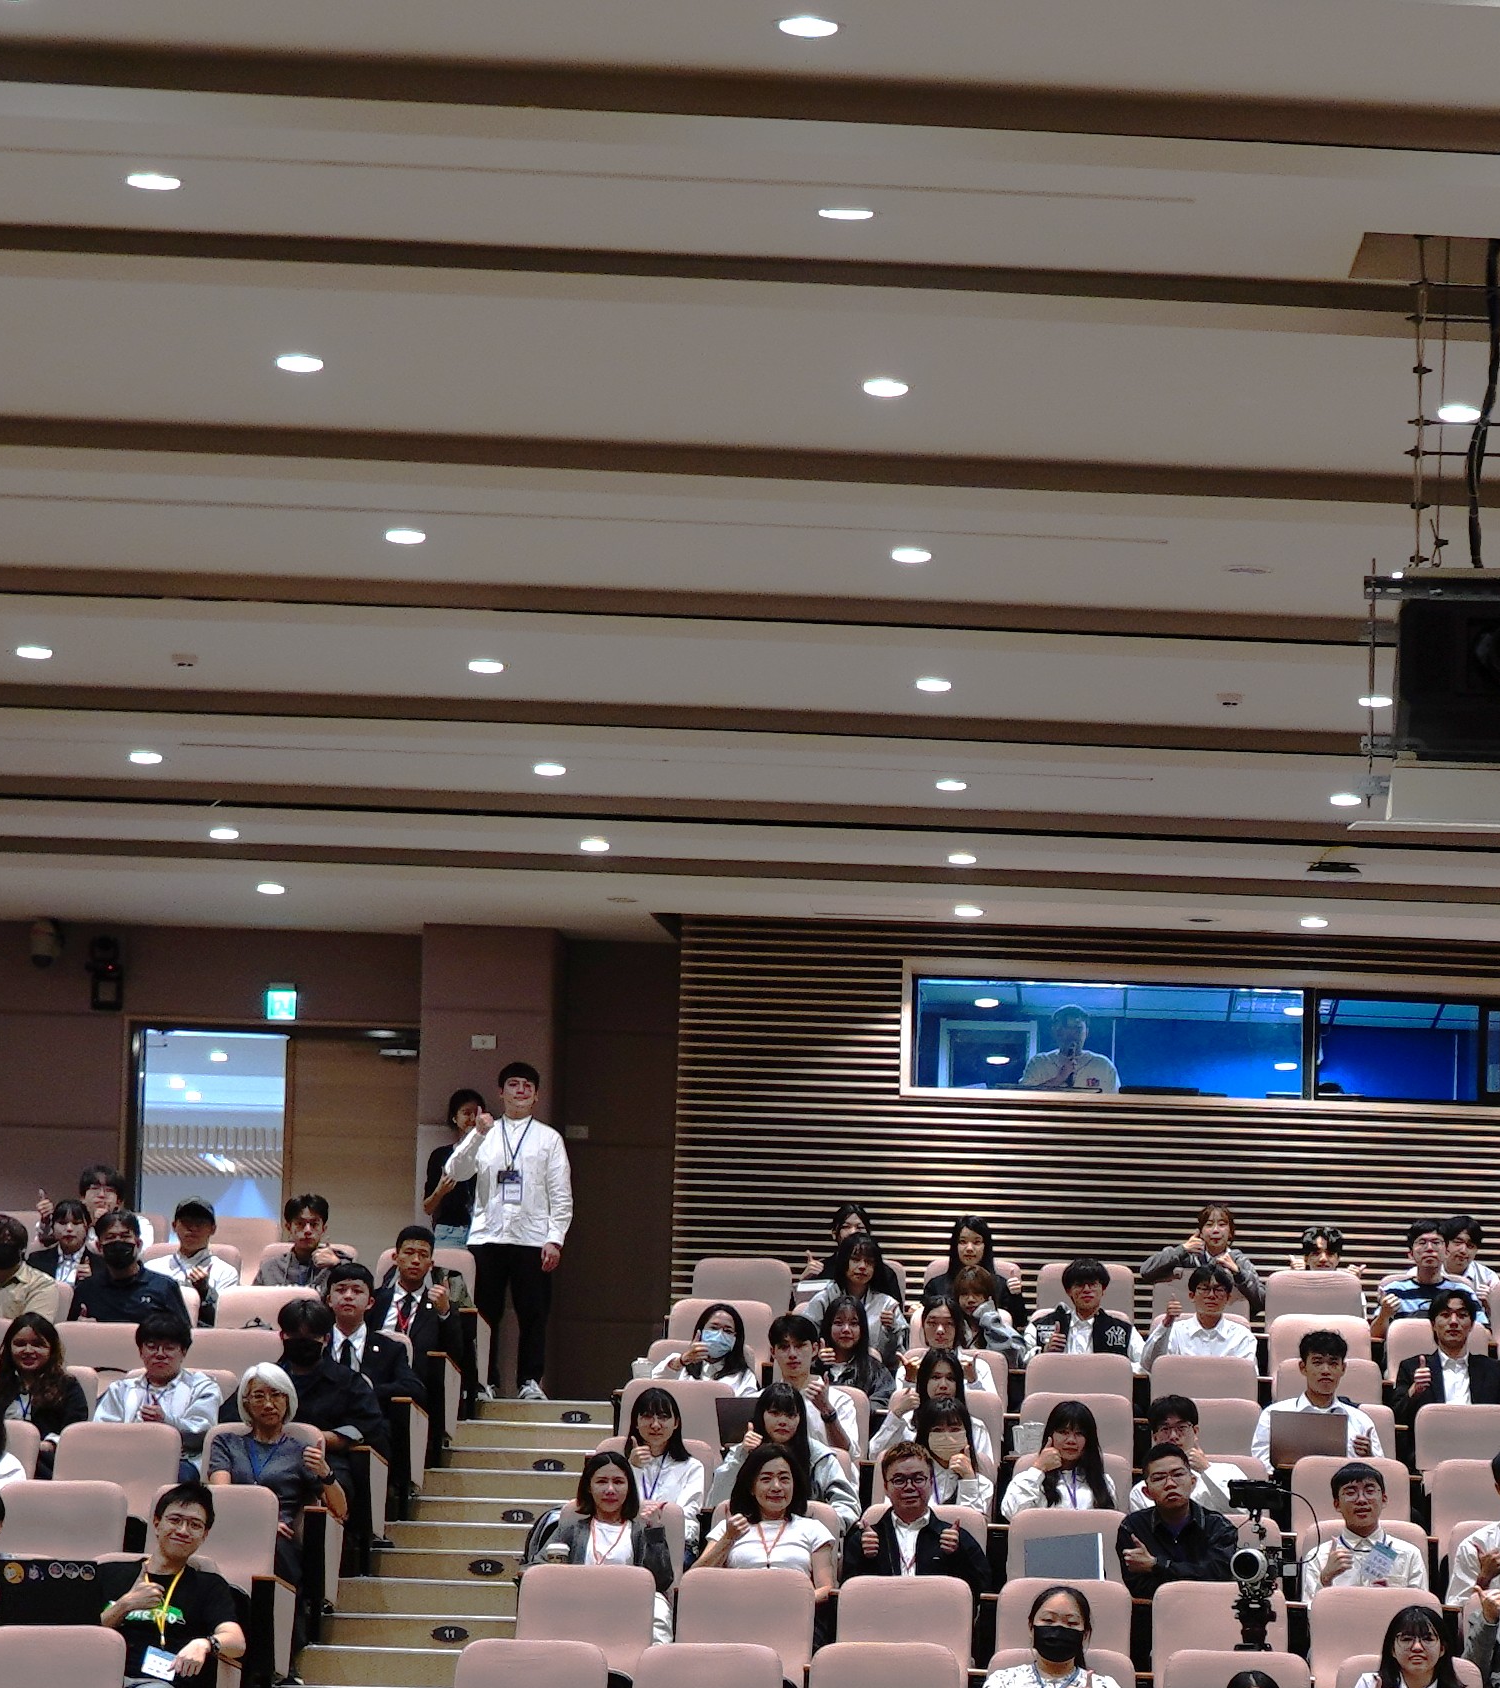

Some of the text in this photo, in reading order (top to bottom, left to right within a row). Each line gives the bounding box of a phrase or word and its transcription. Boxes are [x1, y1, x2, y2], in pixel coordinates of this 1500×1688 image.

[512, 1511, 524, 1522] 13
[480, 1562, 492, 1573] 12
[444, 1629, 455, 1639] 11
